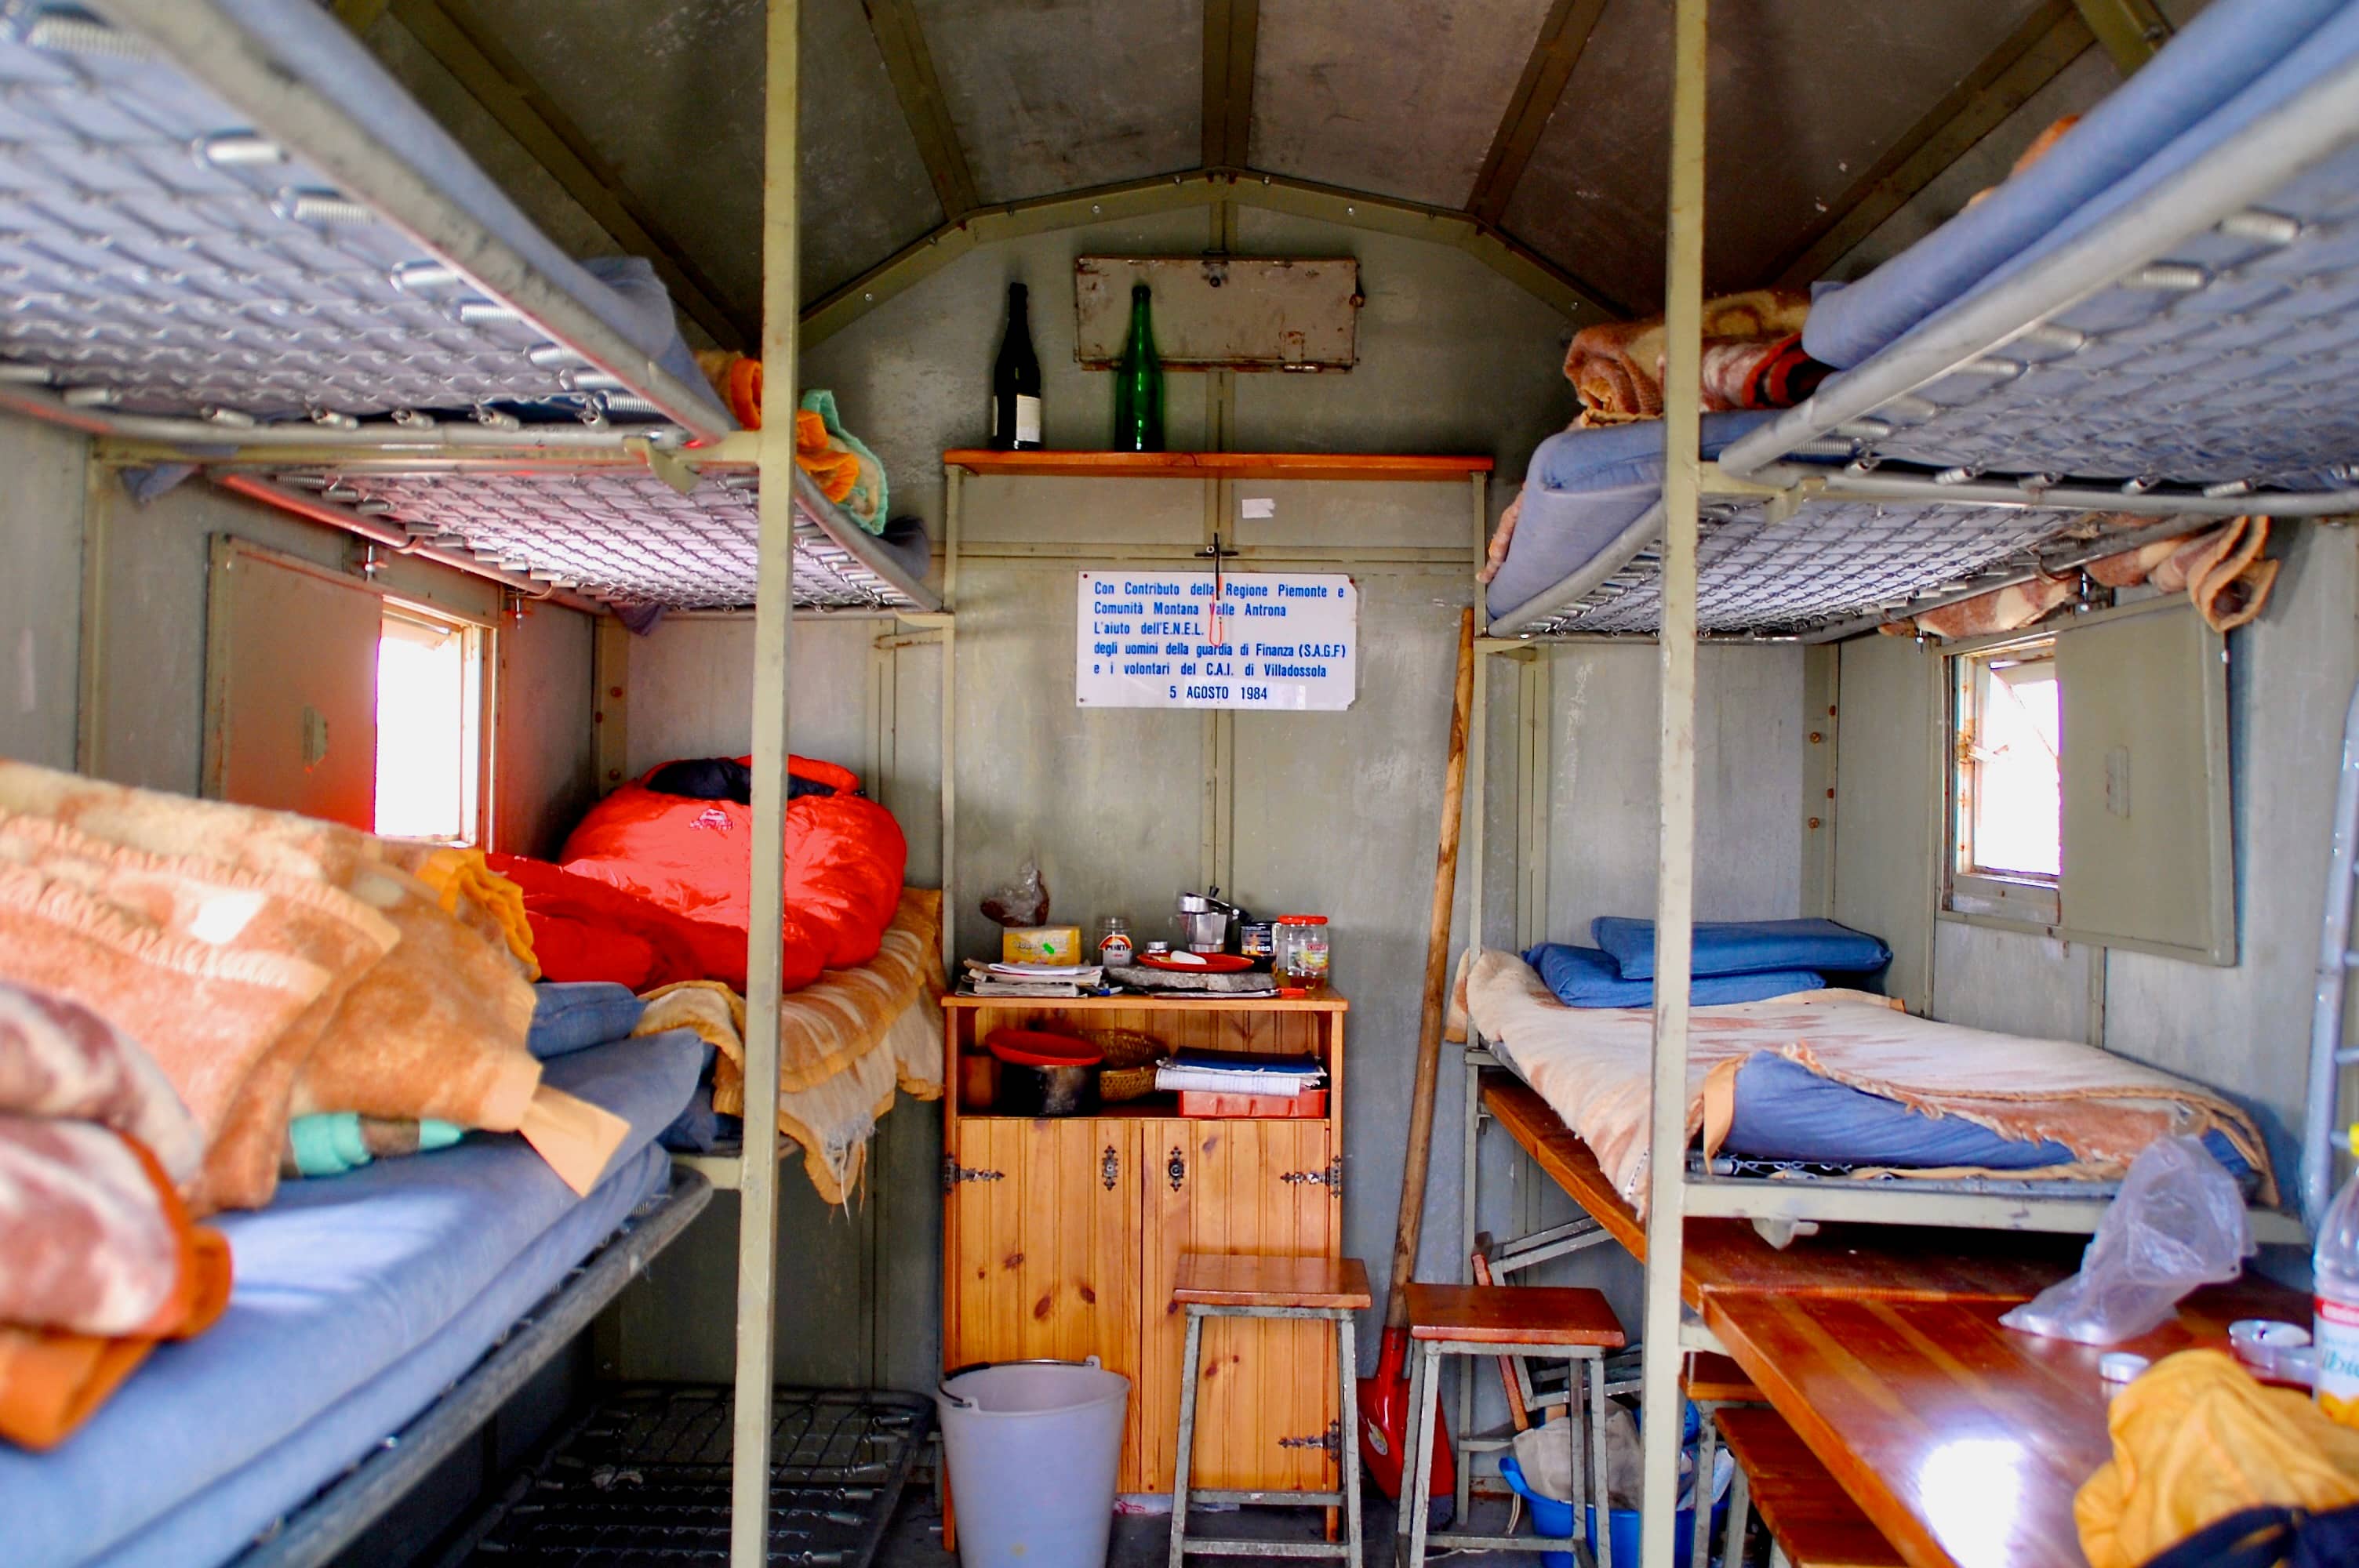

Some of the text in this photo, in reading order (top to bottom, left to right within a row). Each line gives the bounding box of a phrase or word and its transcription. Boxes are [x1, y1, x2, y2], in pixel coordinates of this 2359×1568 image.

[1094, 582, 1344, 599] Con Contributo della Regione Piemonte e
[1094, 601, 1286, 616] Comunità Montana Valle Antrona
[1094, 641, 1118, 657] degli
[1125, 642, 1158, 655] uomini
[1165, 642, 1189, 655] della
[1196, 643, 1233, 658] guardia
[1240, 643, 1249, 656] di
[1256, 643, 1294, 656] Finanza
[1094, 662, 1327, 677] e i volontari del C.A.I. di Villadossola
[1169, 685, 1267, 700] 5 AGOSTO 1984
